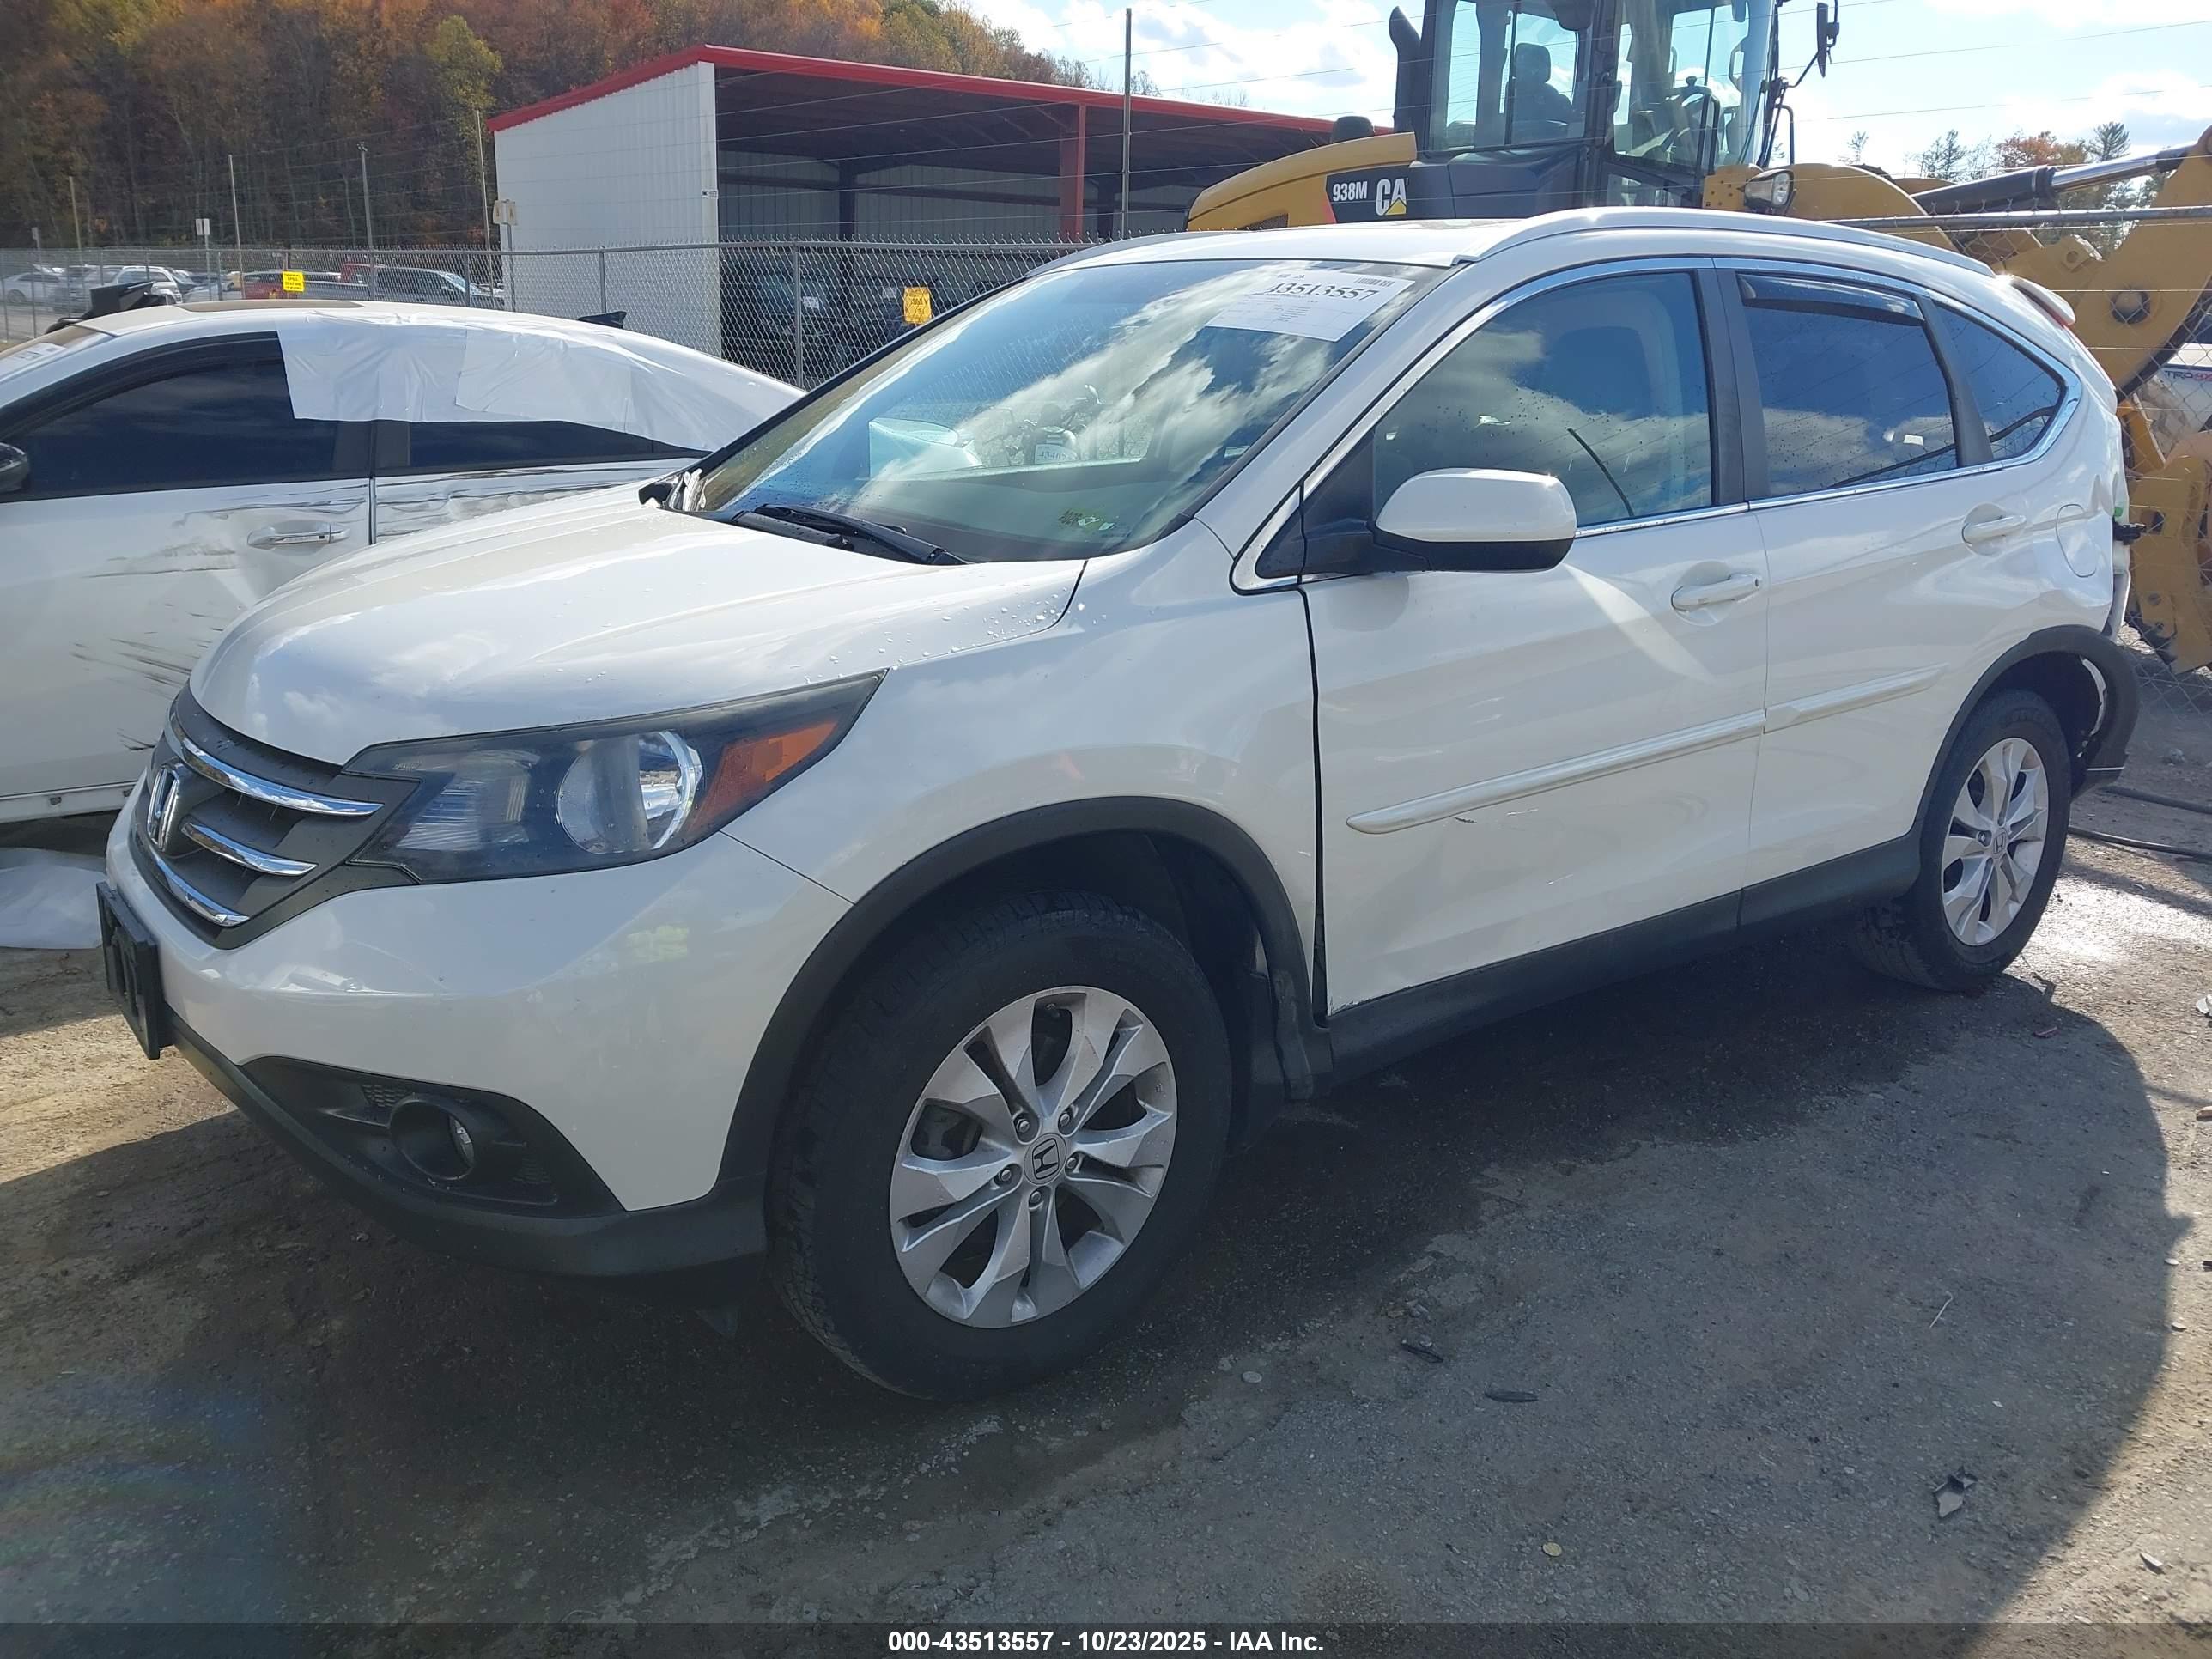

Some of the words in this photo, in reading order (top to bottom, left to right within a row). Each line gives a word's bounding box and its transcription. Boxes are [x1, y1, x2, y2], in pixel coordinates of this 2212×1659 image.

[1333, 180, 1368, 202] 938M
[1376, 177, 1409, 216] CA
[1266, 282, 1381, 301] 43513557
